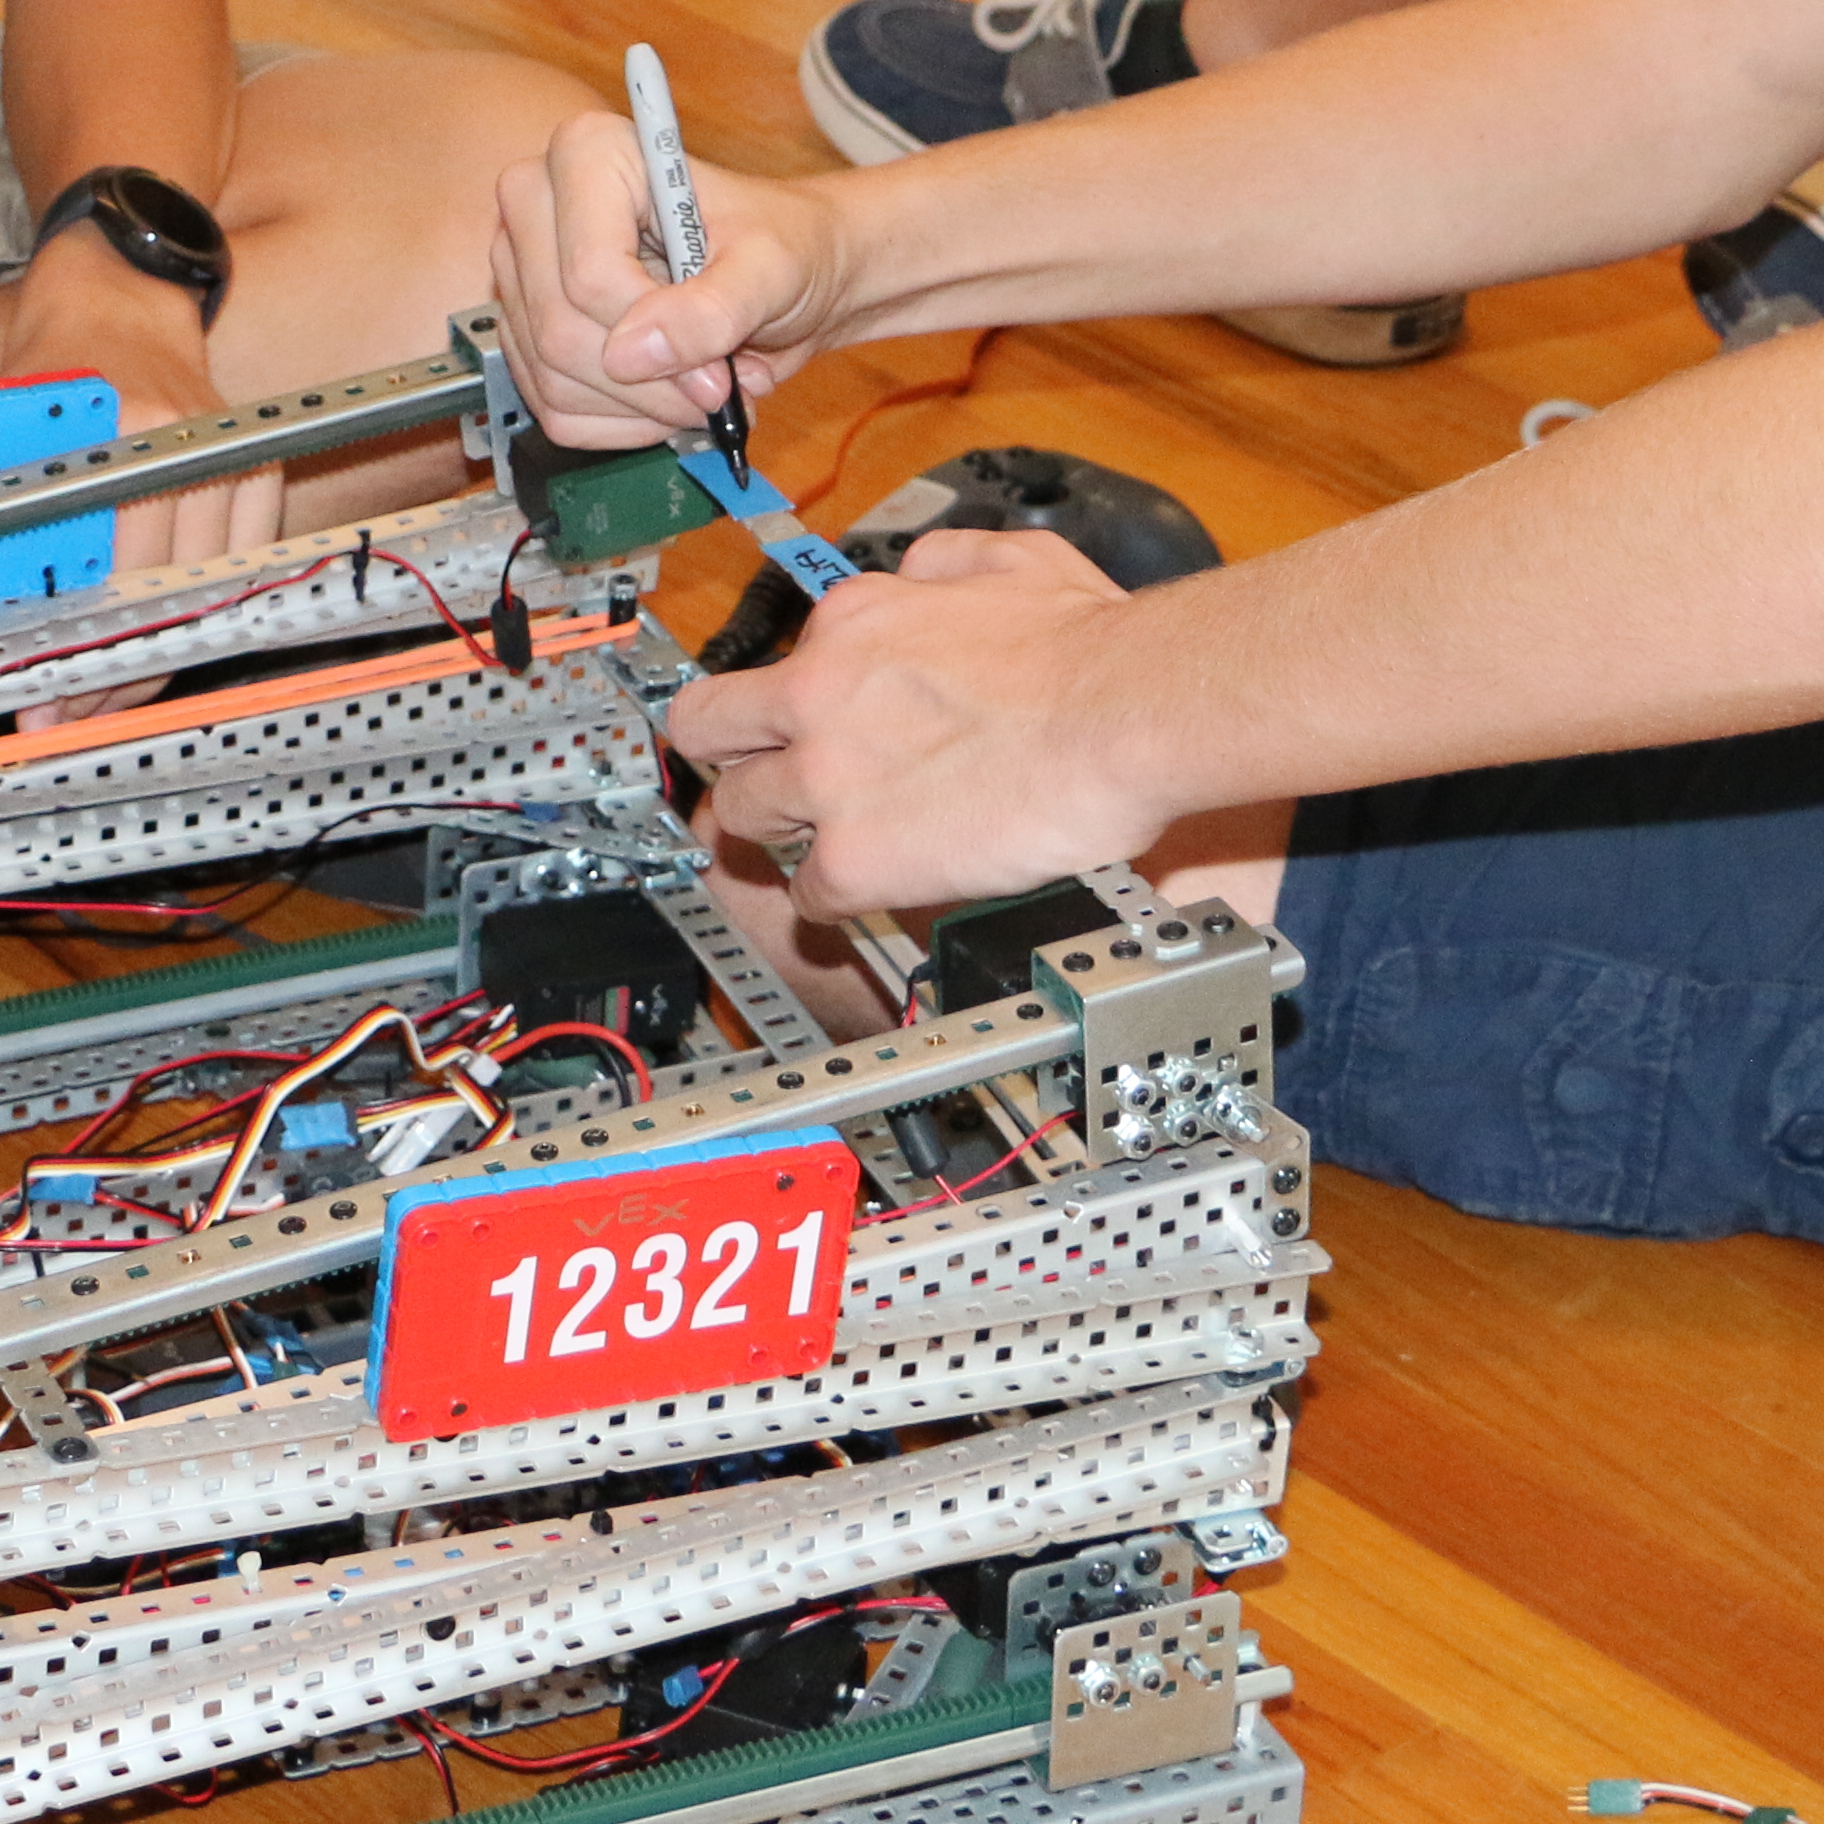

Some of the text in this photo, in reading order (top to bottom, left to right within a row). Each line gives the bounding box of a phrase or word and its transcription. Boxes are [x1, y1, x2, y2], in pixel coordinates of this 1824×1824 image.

[673, 196, 707, 278] Sharpie
[573, 1193, 689, 1237] VEX
[489, 1210, 824, 1364] 12321
